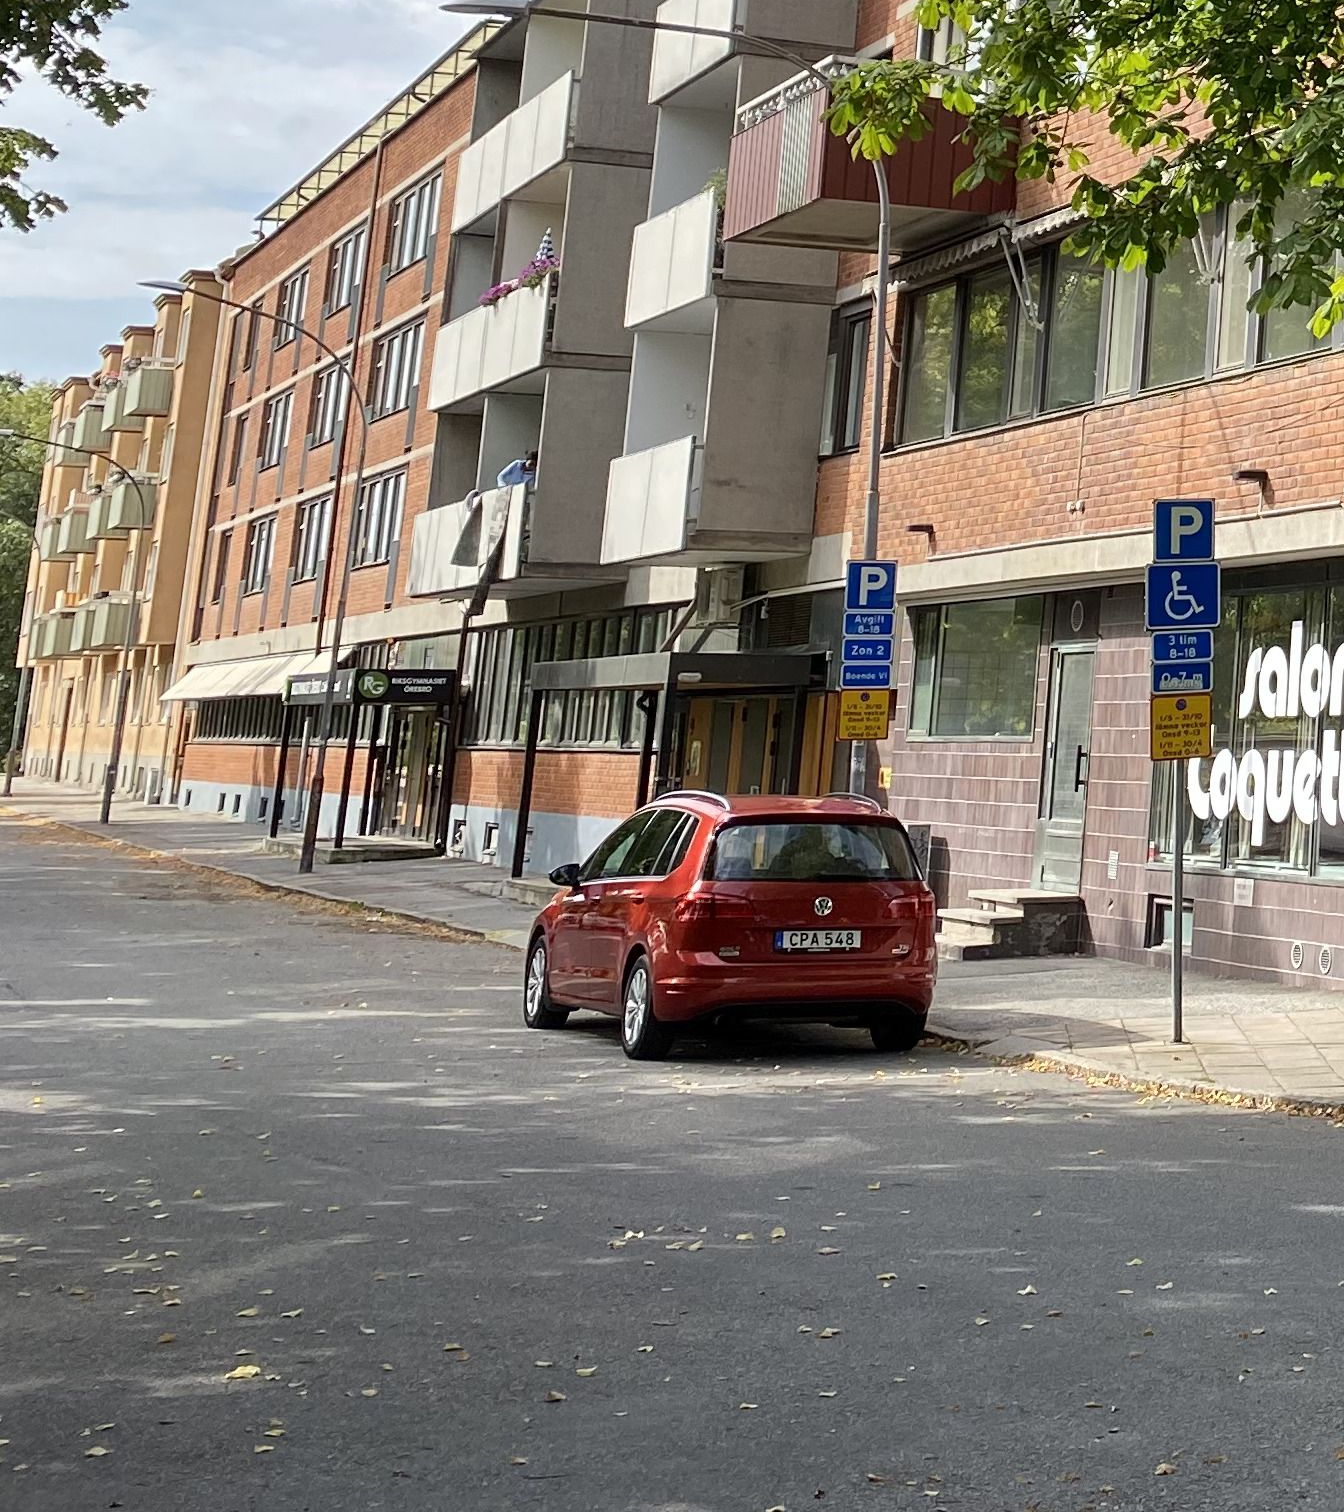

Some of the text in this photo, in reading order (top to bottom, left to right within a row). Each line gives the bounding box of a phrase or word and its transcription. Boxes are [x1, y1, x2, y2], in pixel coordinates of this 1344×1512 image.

[1170, 506, 1203, 555] P
[858, 566, 888, 606] P
[854, 614, 885, 625] Avgift
[857, 625, 880, 634] 8-18
[1168, 635, 1176, 646] 3
[851, 645, 885, 656] Zon 2
[1169, 647, 1197, 659] 8-18
[845, 672, 876, 680] Boende
[363, 675, 385, 695] RG
[789, 932, 855, 947] CPA 548
